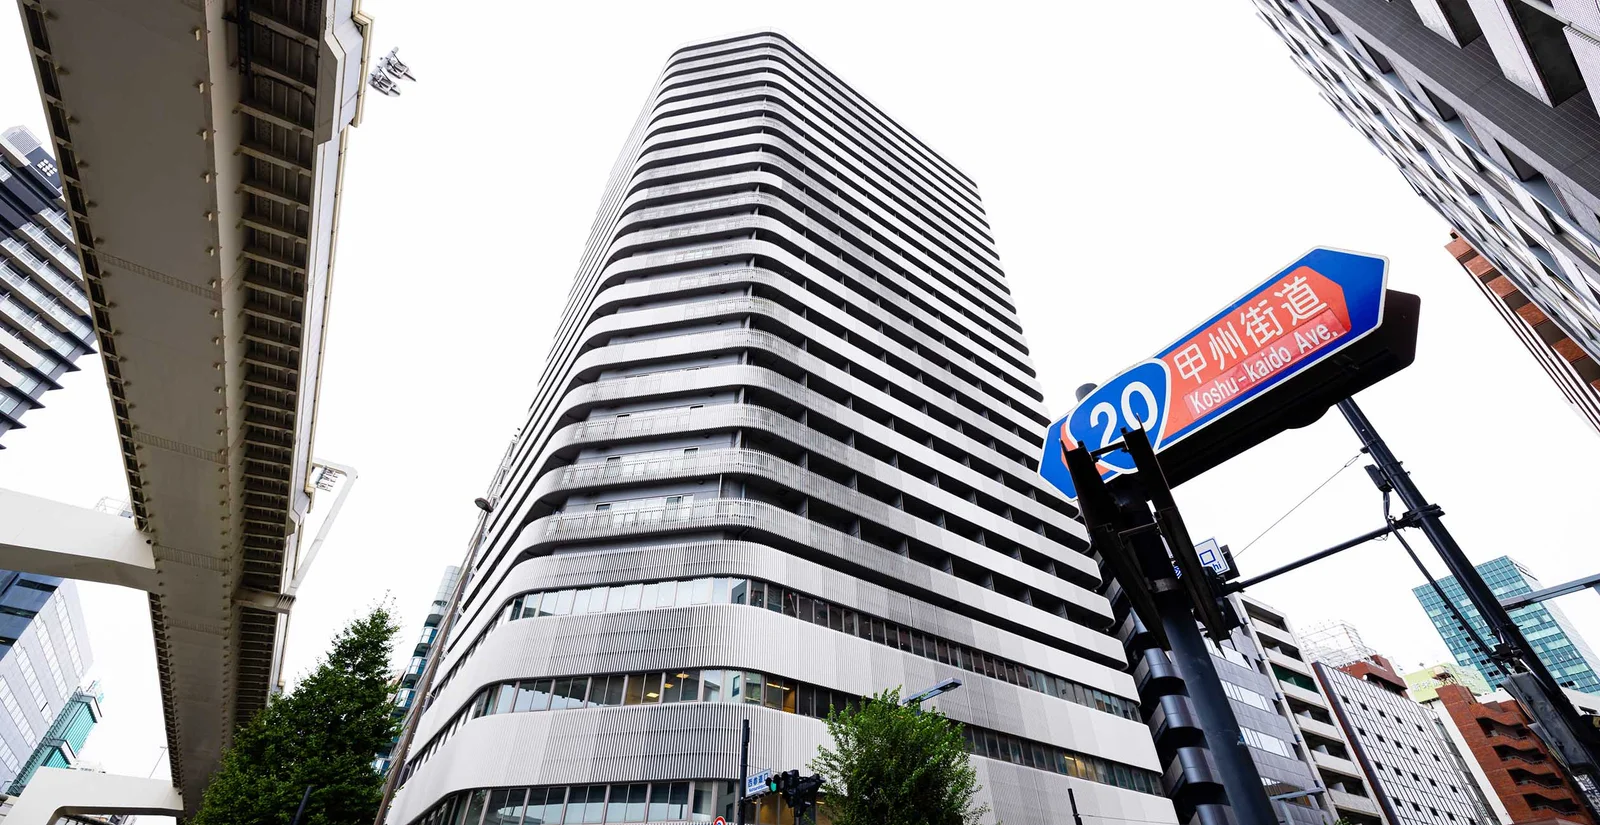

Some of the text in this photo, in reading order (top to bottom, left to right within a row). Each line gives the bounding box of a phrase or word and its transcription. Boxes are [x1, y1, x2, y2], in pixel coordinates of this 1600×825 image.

[1173, 276, 1328, 385] 甲州街道
[1189, 323, 1338, 414] Koshu-kaido Ave.
[1089, 381, 1159, 458] 20
